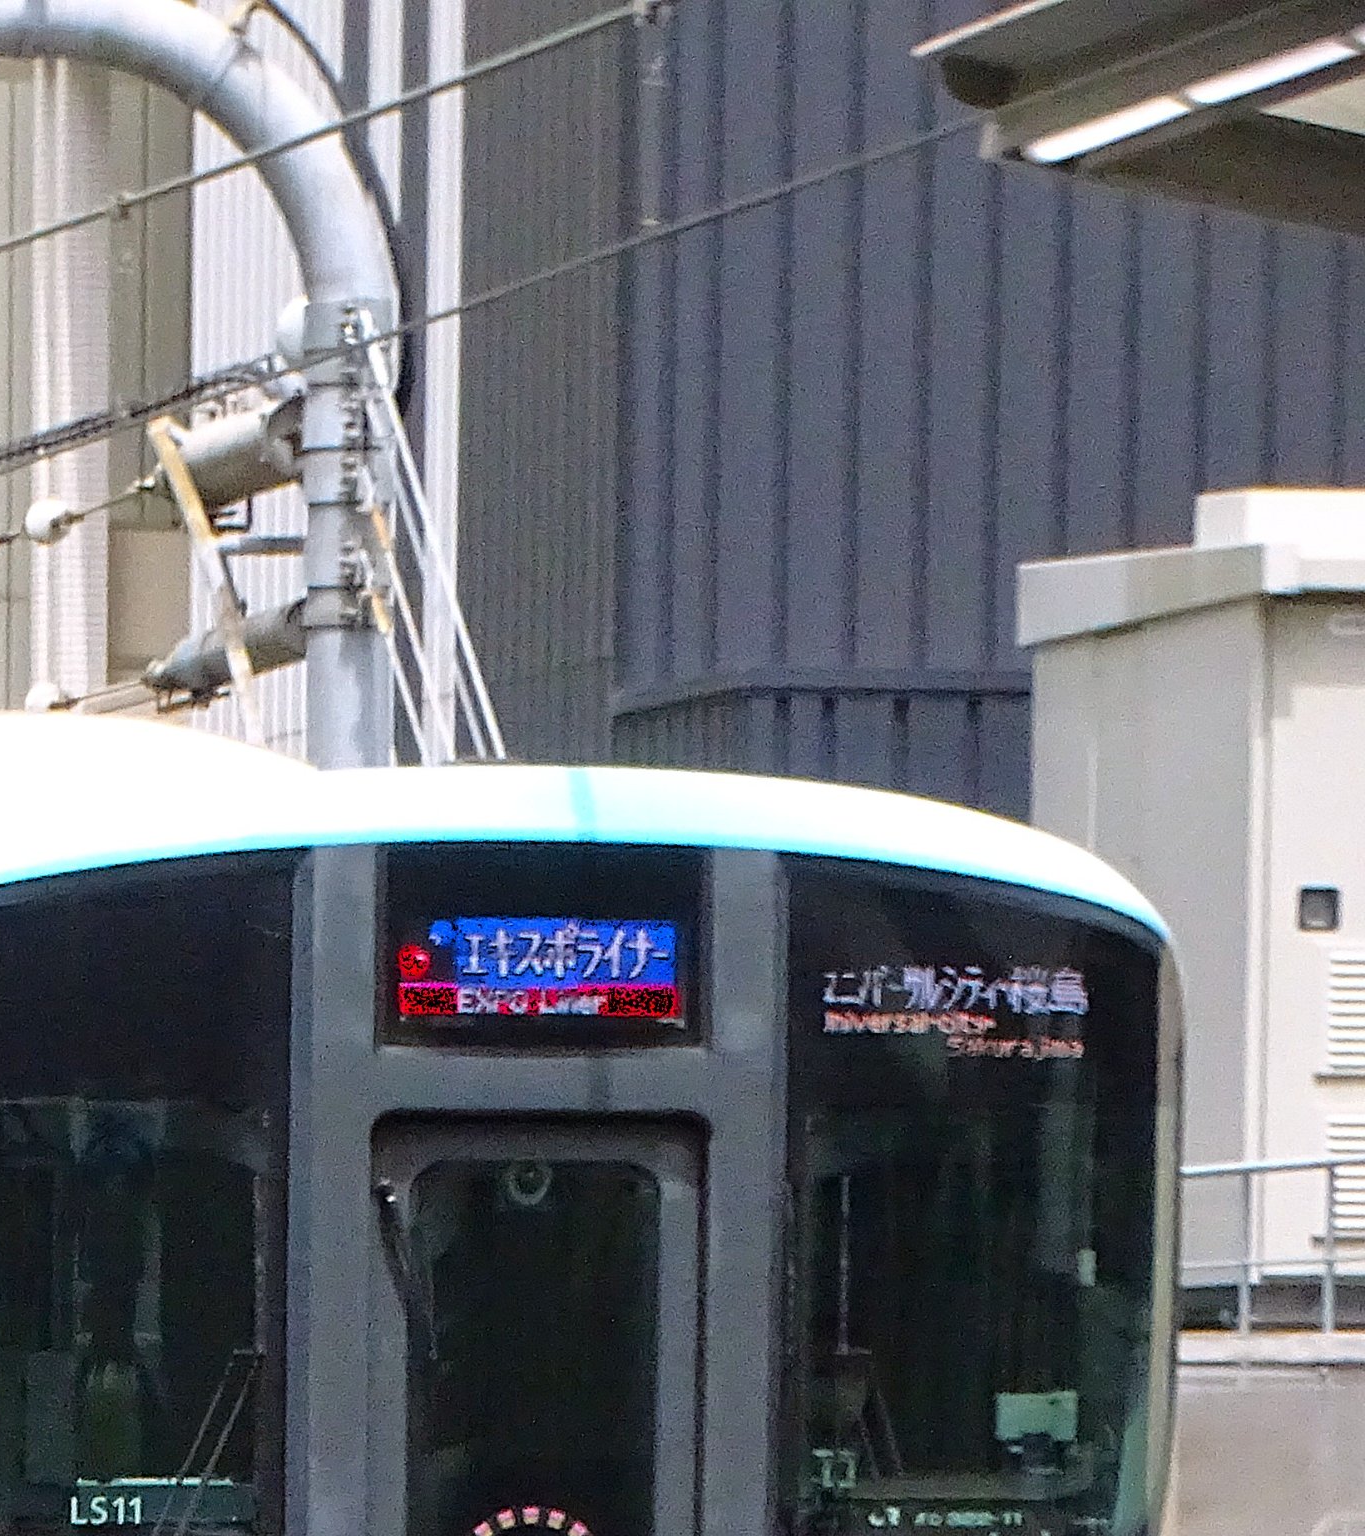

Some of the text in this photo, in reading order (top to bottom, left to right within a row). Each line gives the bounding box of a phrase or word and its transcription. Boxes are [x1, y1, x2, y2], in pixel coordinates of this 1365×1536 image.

[461, 920, 670, 979] エキスポライナー
[69, 1495, 143, 1526] LS11
